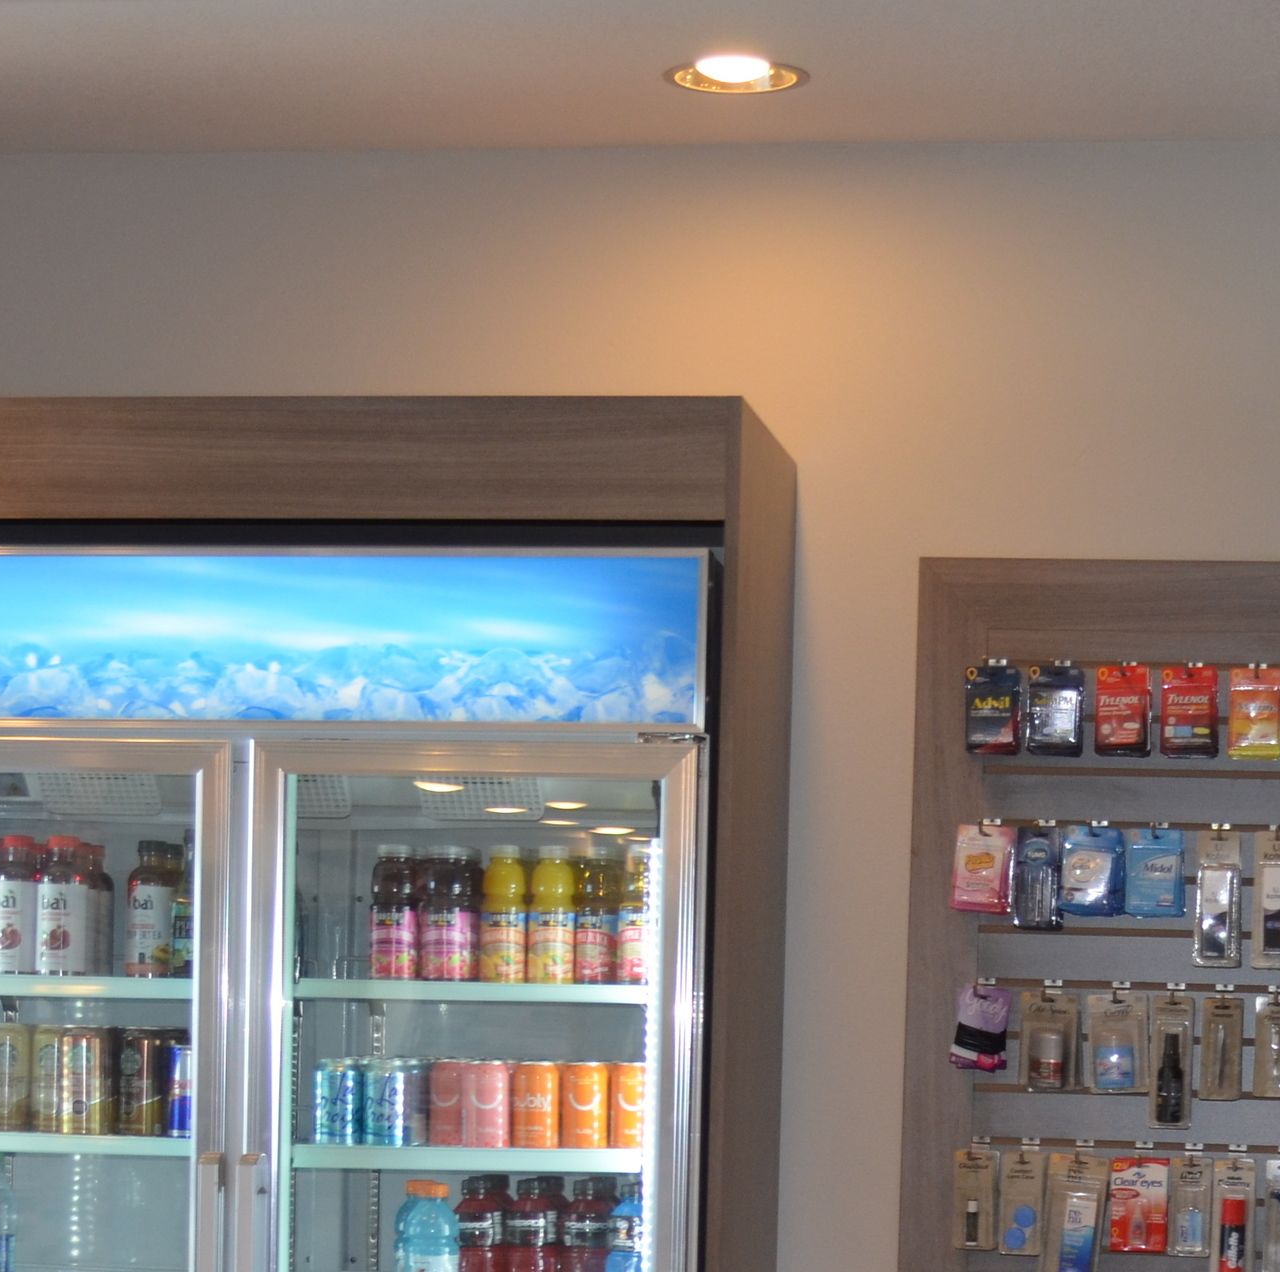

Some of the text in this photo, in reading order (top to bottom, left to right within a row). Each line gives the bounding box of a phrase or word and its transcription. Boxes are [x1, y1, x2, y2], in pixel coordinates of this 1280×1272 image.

[972, 697, 1010, 709] Advil
[1143, 863, 1173, 874] Midol
[132, 894, 154, 910] bai
[1113, 1176, 1163, 1188] Clear eyes
